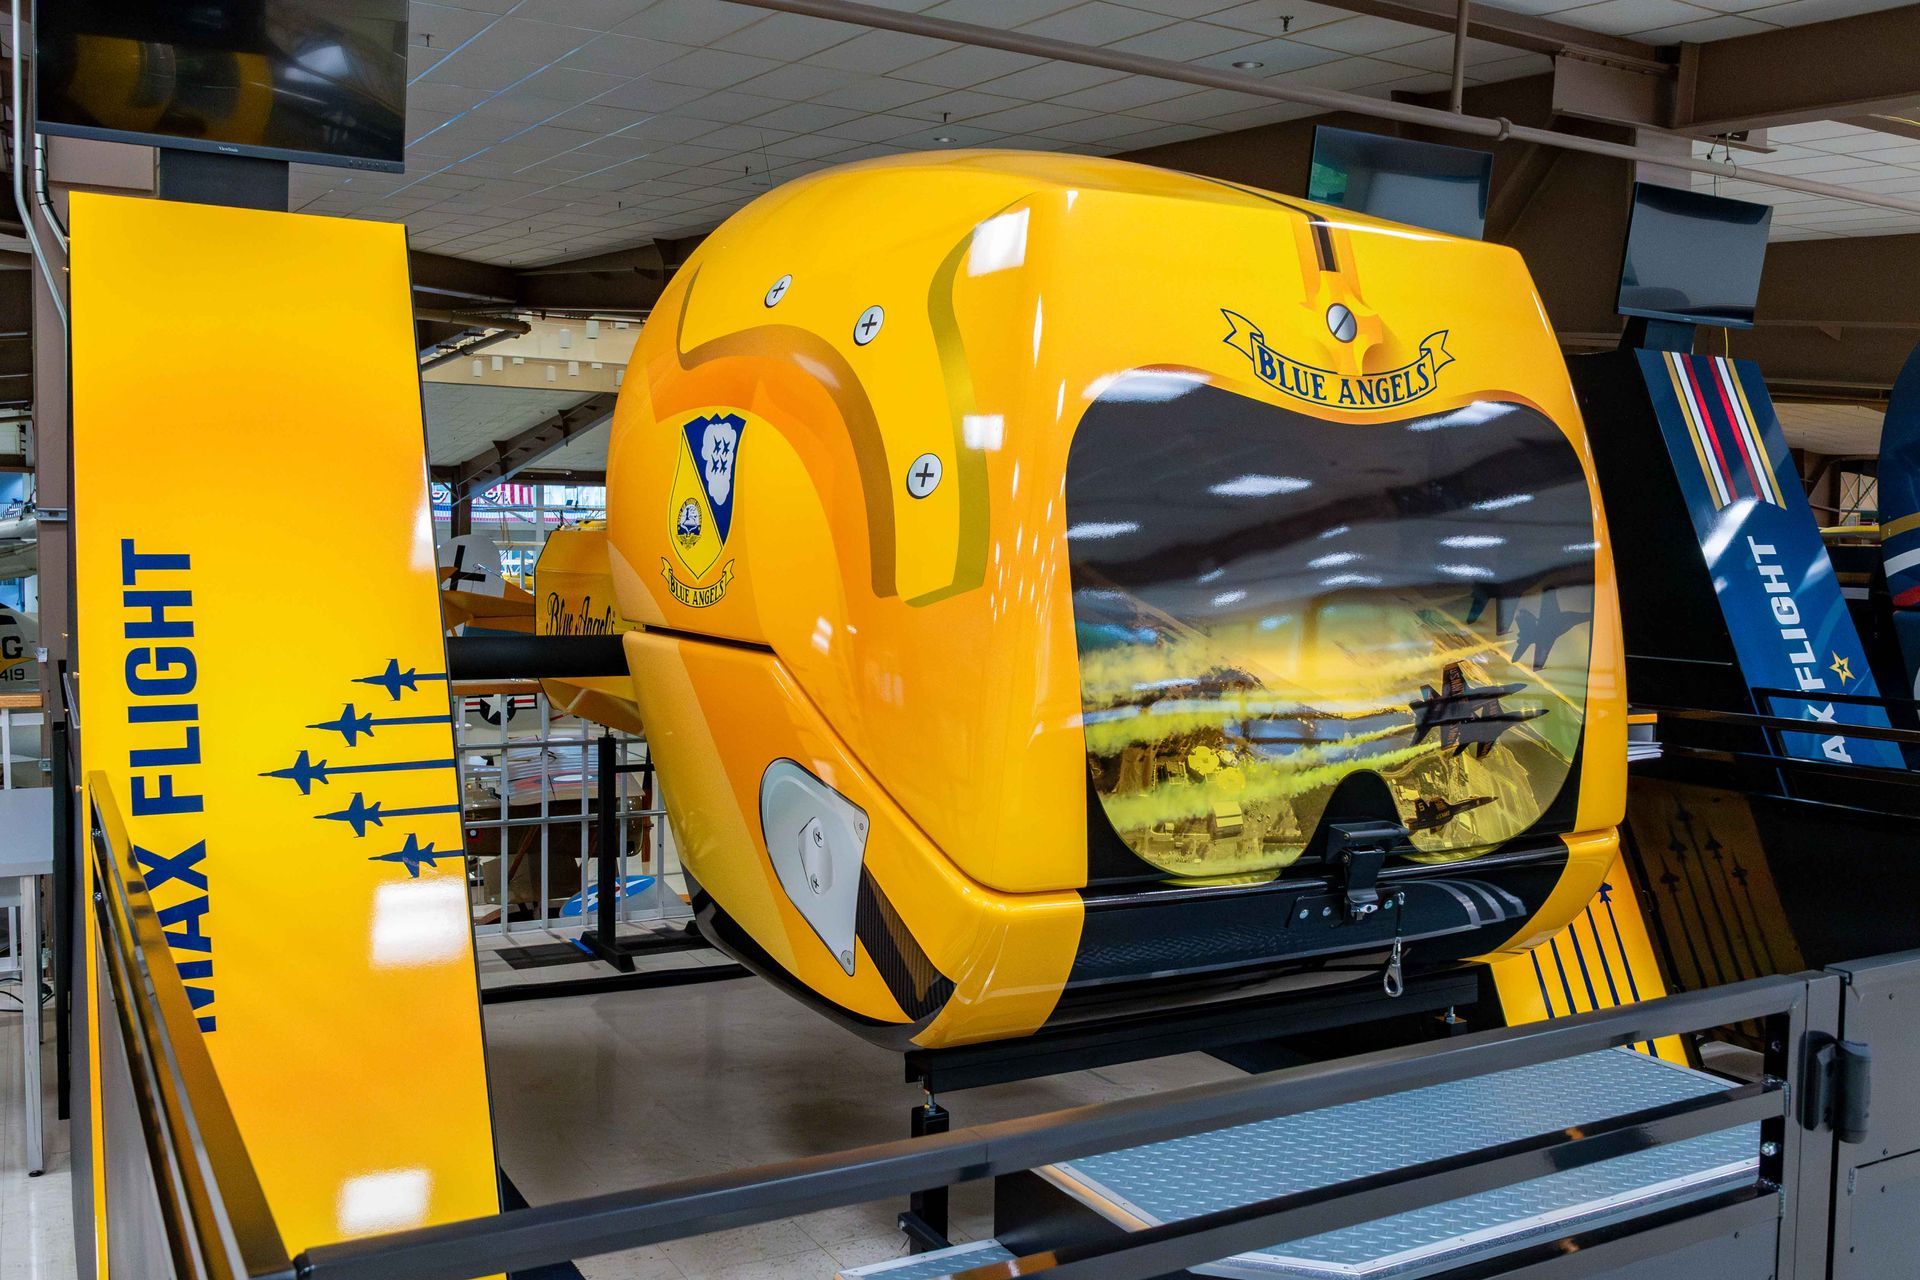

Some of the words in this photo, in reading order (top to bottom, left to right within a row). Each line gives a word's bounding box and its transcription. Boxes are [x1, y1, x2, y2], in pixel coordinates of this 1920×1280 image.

[1257, 345, 1327, 401] BLUE
[1338, 362, 1430, 406] ANGELS
[670, 575, 690, 603] BLUE
[692, 580, 725, 606] ANGELS
[1747, 535, 1826, 690] FLIGHT
[2, 635, 23, 659] G
[120, 538, 205, 817] FLIGHT
[1807, 702, 1853, 763] AX
